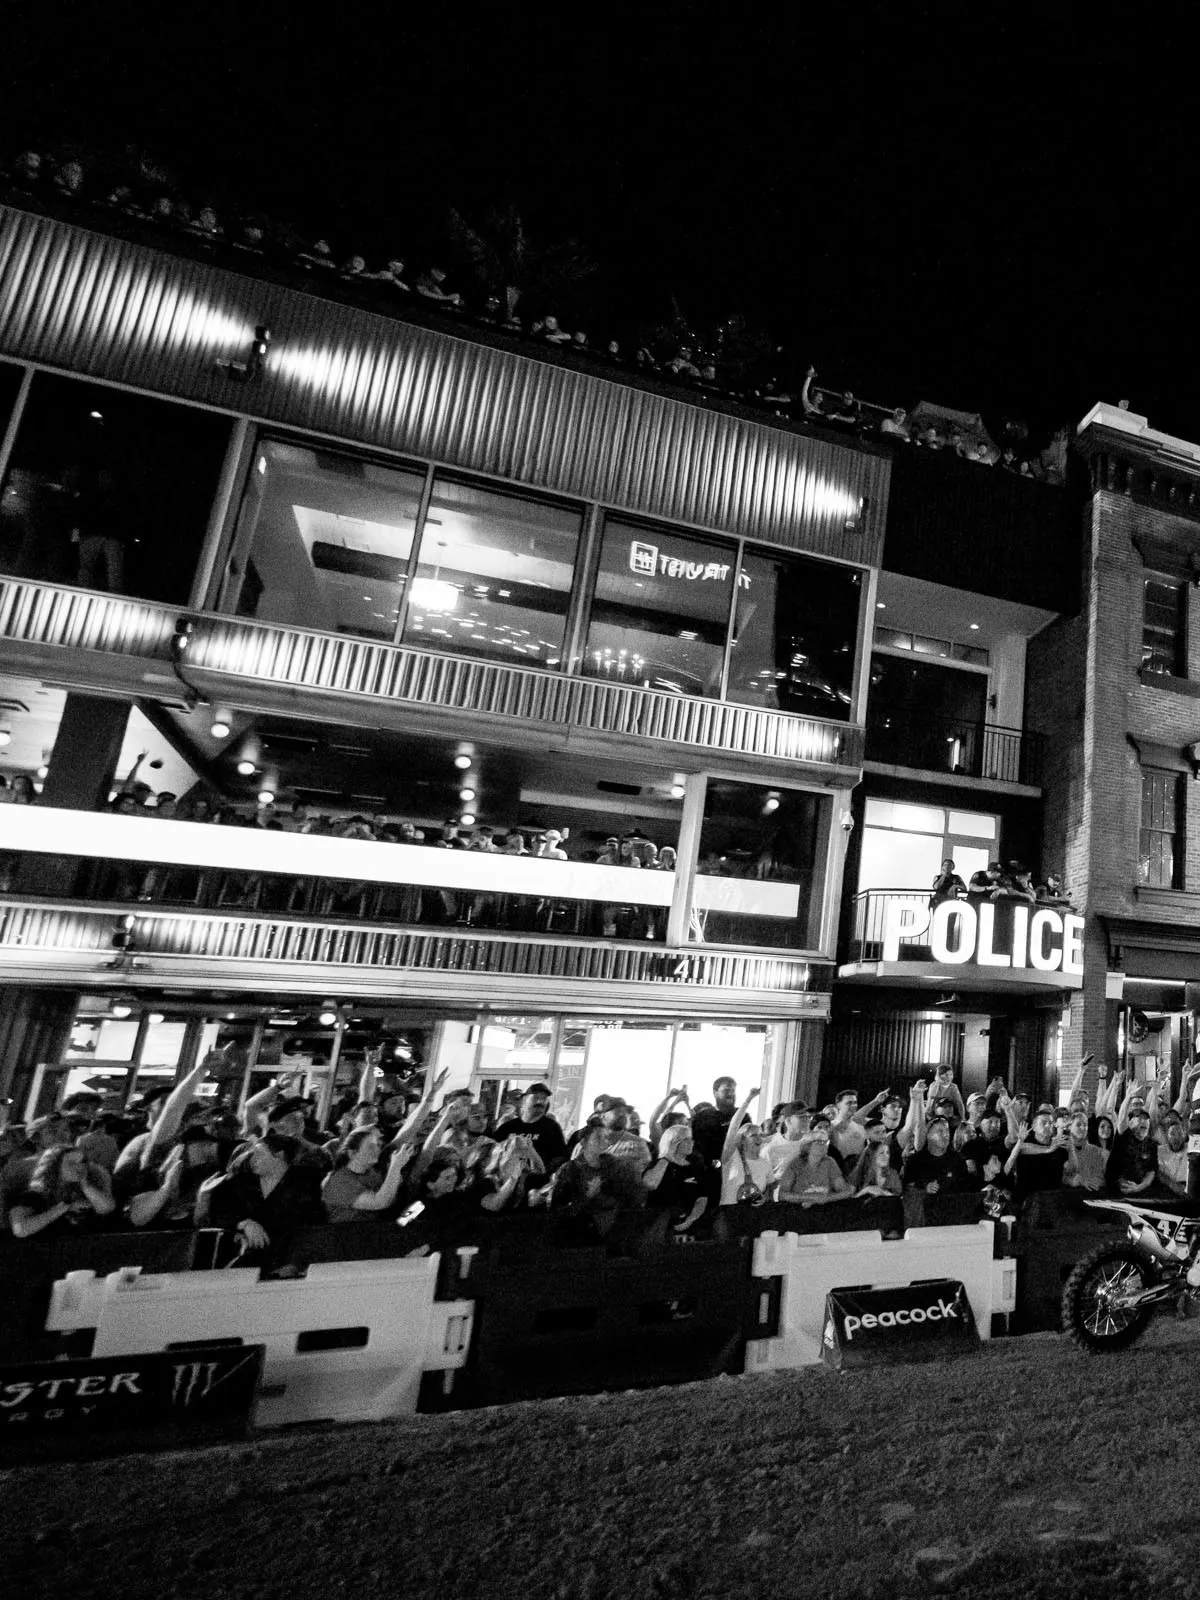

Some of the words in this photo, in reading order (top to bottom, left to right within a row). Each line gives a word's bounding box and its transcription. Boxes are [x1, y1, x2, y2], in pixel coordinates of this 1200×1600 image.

[882, 899, 1085, 976] POLICE
[843, 1298, 958, 1340] peacock
[0, 1372, 142, 1407] STER
[8, 1404, 97, 1422] RGY
